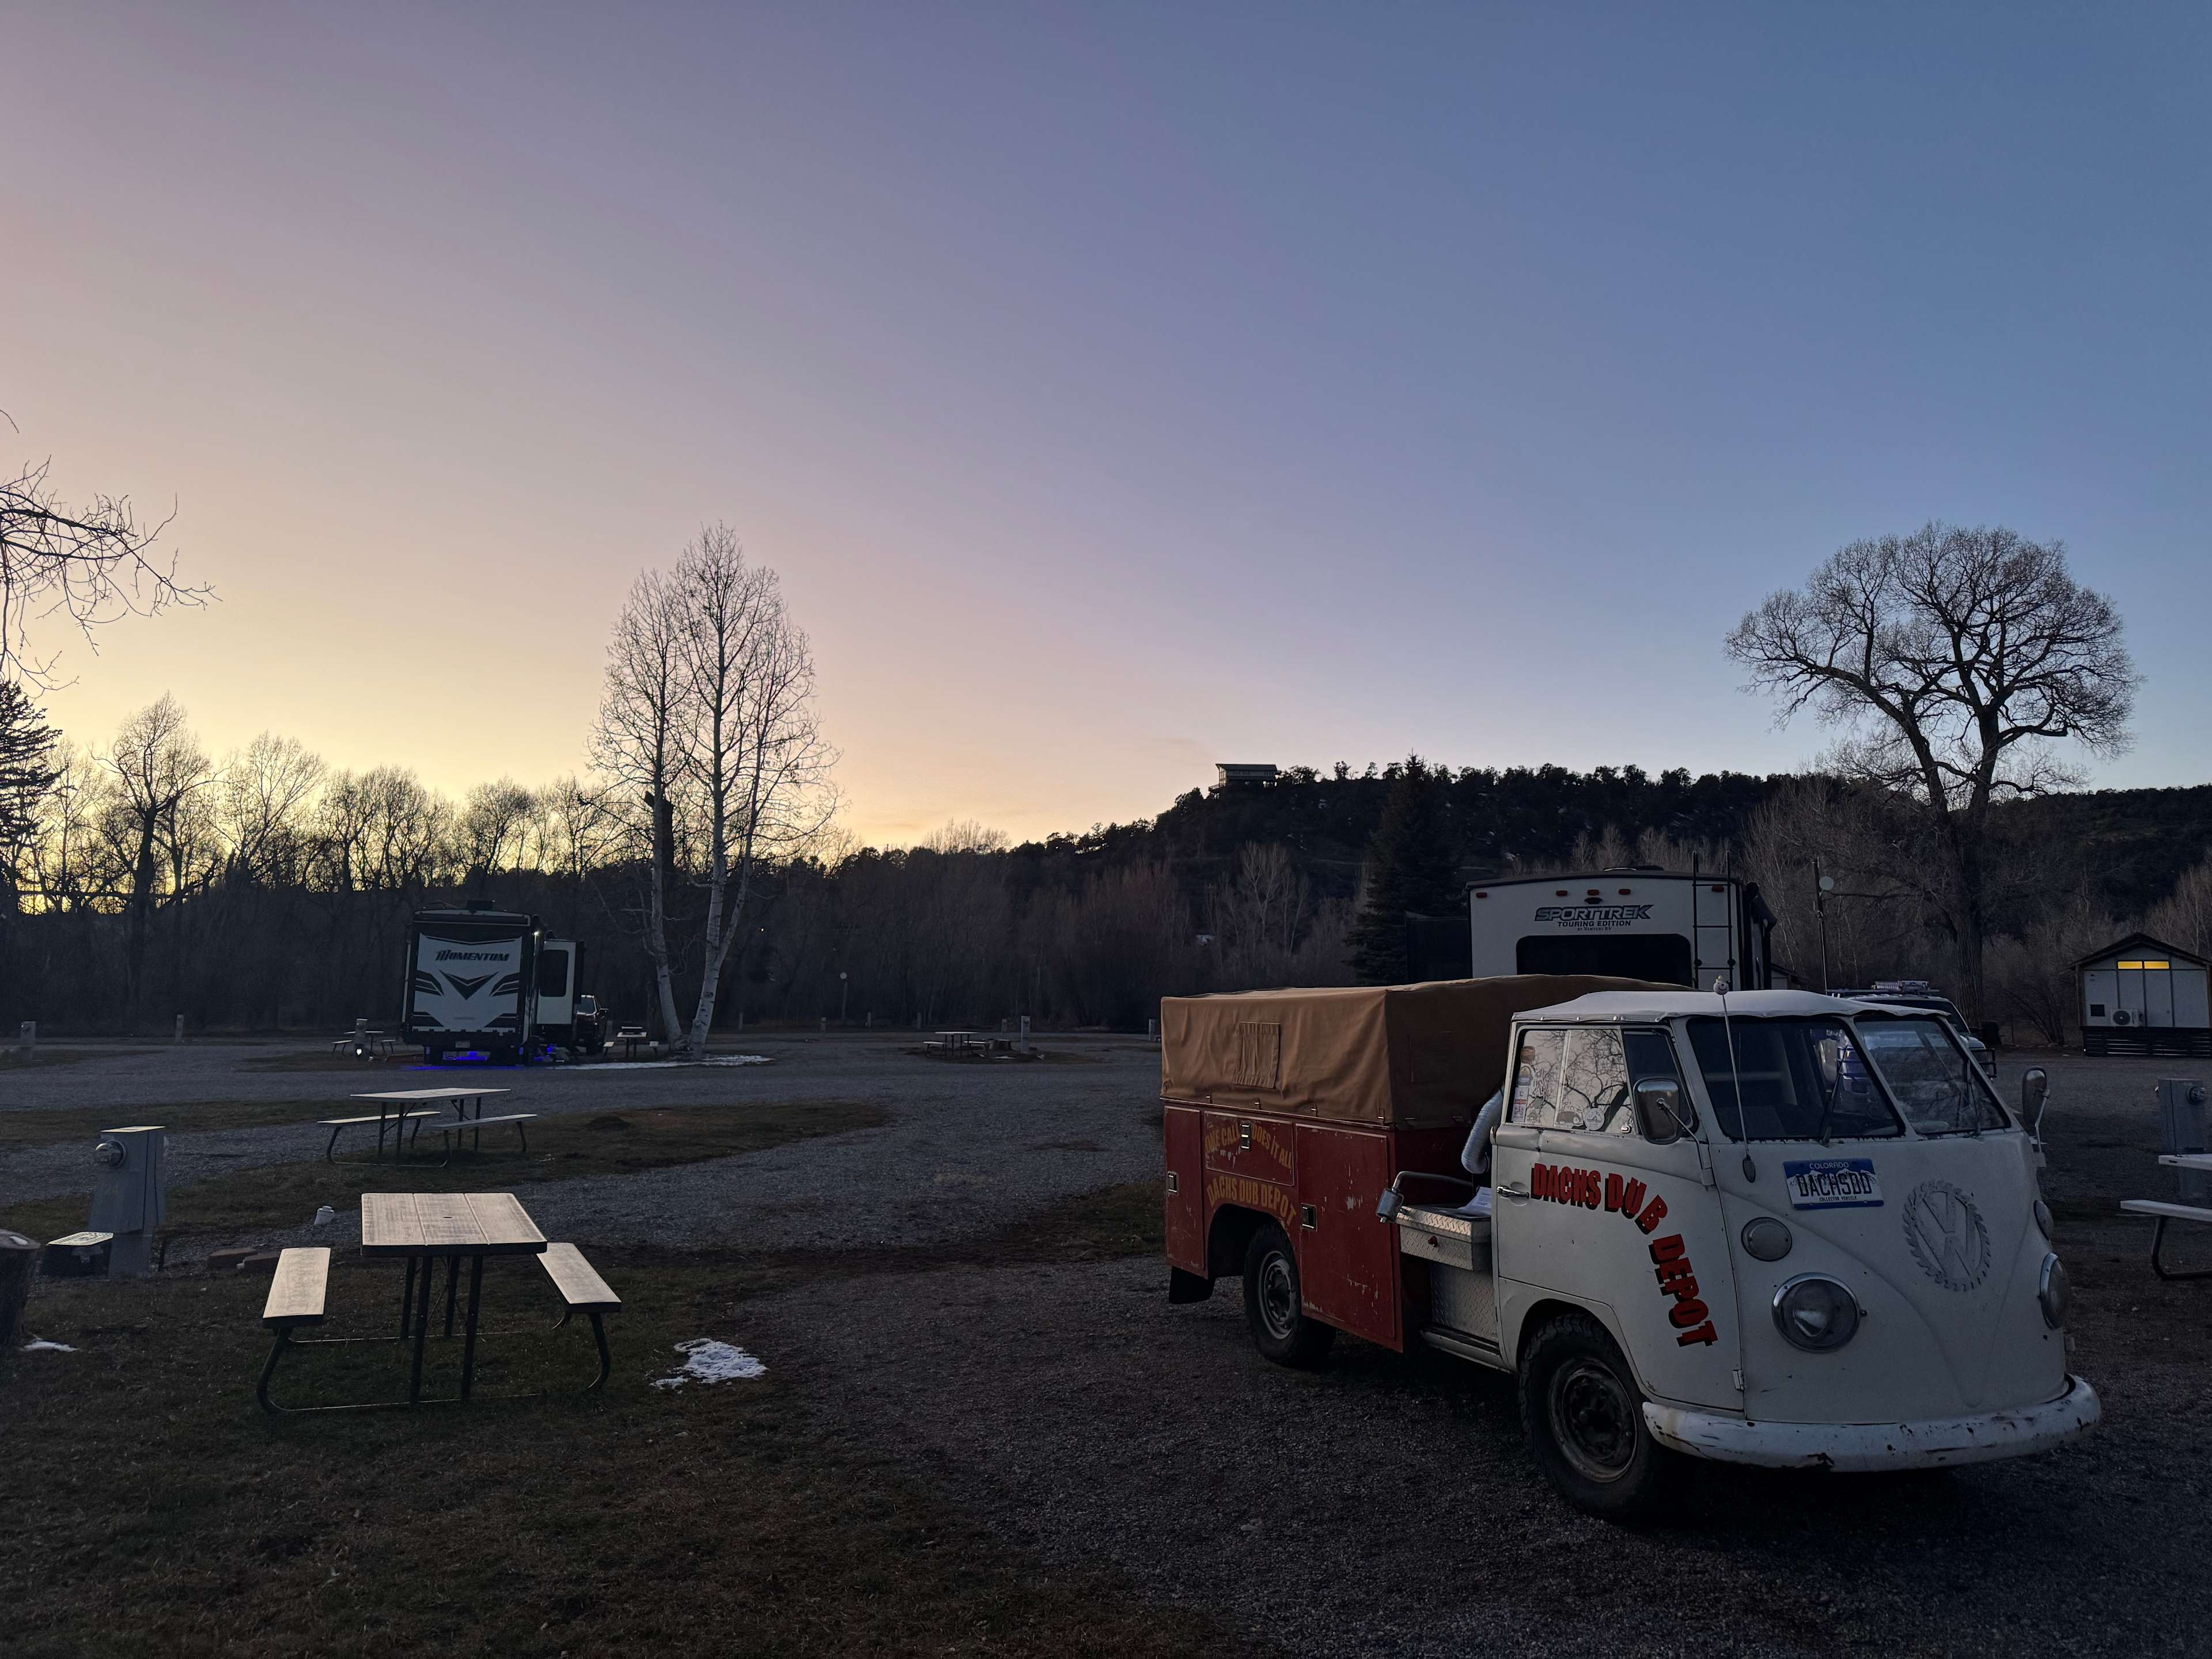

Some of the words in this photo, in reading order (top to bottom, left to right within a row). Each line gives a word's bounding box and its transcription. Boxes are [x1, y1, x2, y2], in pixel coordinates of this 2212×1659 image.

[1535, 904, 1654, 921] SPORTTREK
[435, 949, 509, 961] MOMENTUM
[1205, 1130, 1219, 1152] ONE
[1252, 1124, 1271, 1150] DOES
[1279, 1148, 1292, 1169] ALL
[1809, 1161, 1850, 1169] COLORADO
[1207, 1176, 1237, 1207] DACHS
[1239, 1179, 1259, 1205] DUB
[1261, 1184, 1297, 1226] DEPOT
[1531, 1163, 1601, 1210] DACHS
[1604, 1173, 1668, 1234] DUB
[1648, 1234, 1718, 1347] DEPOT
